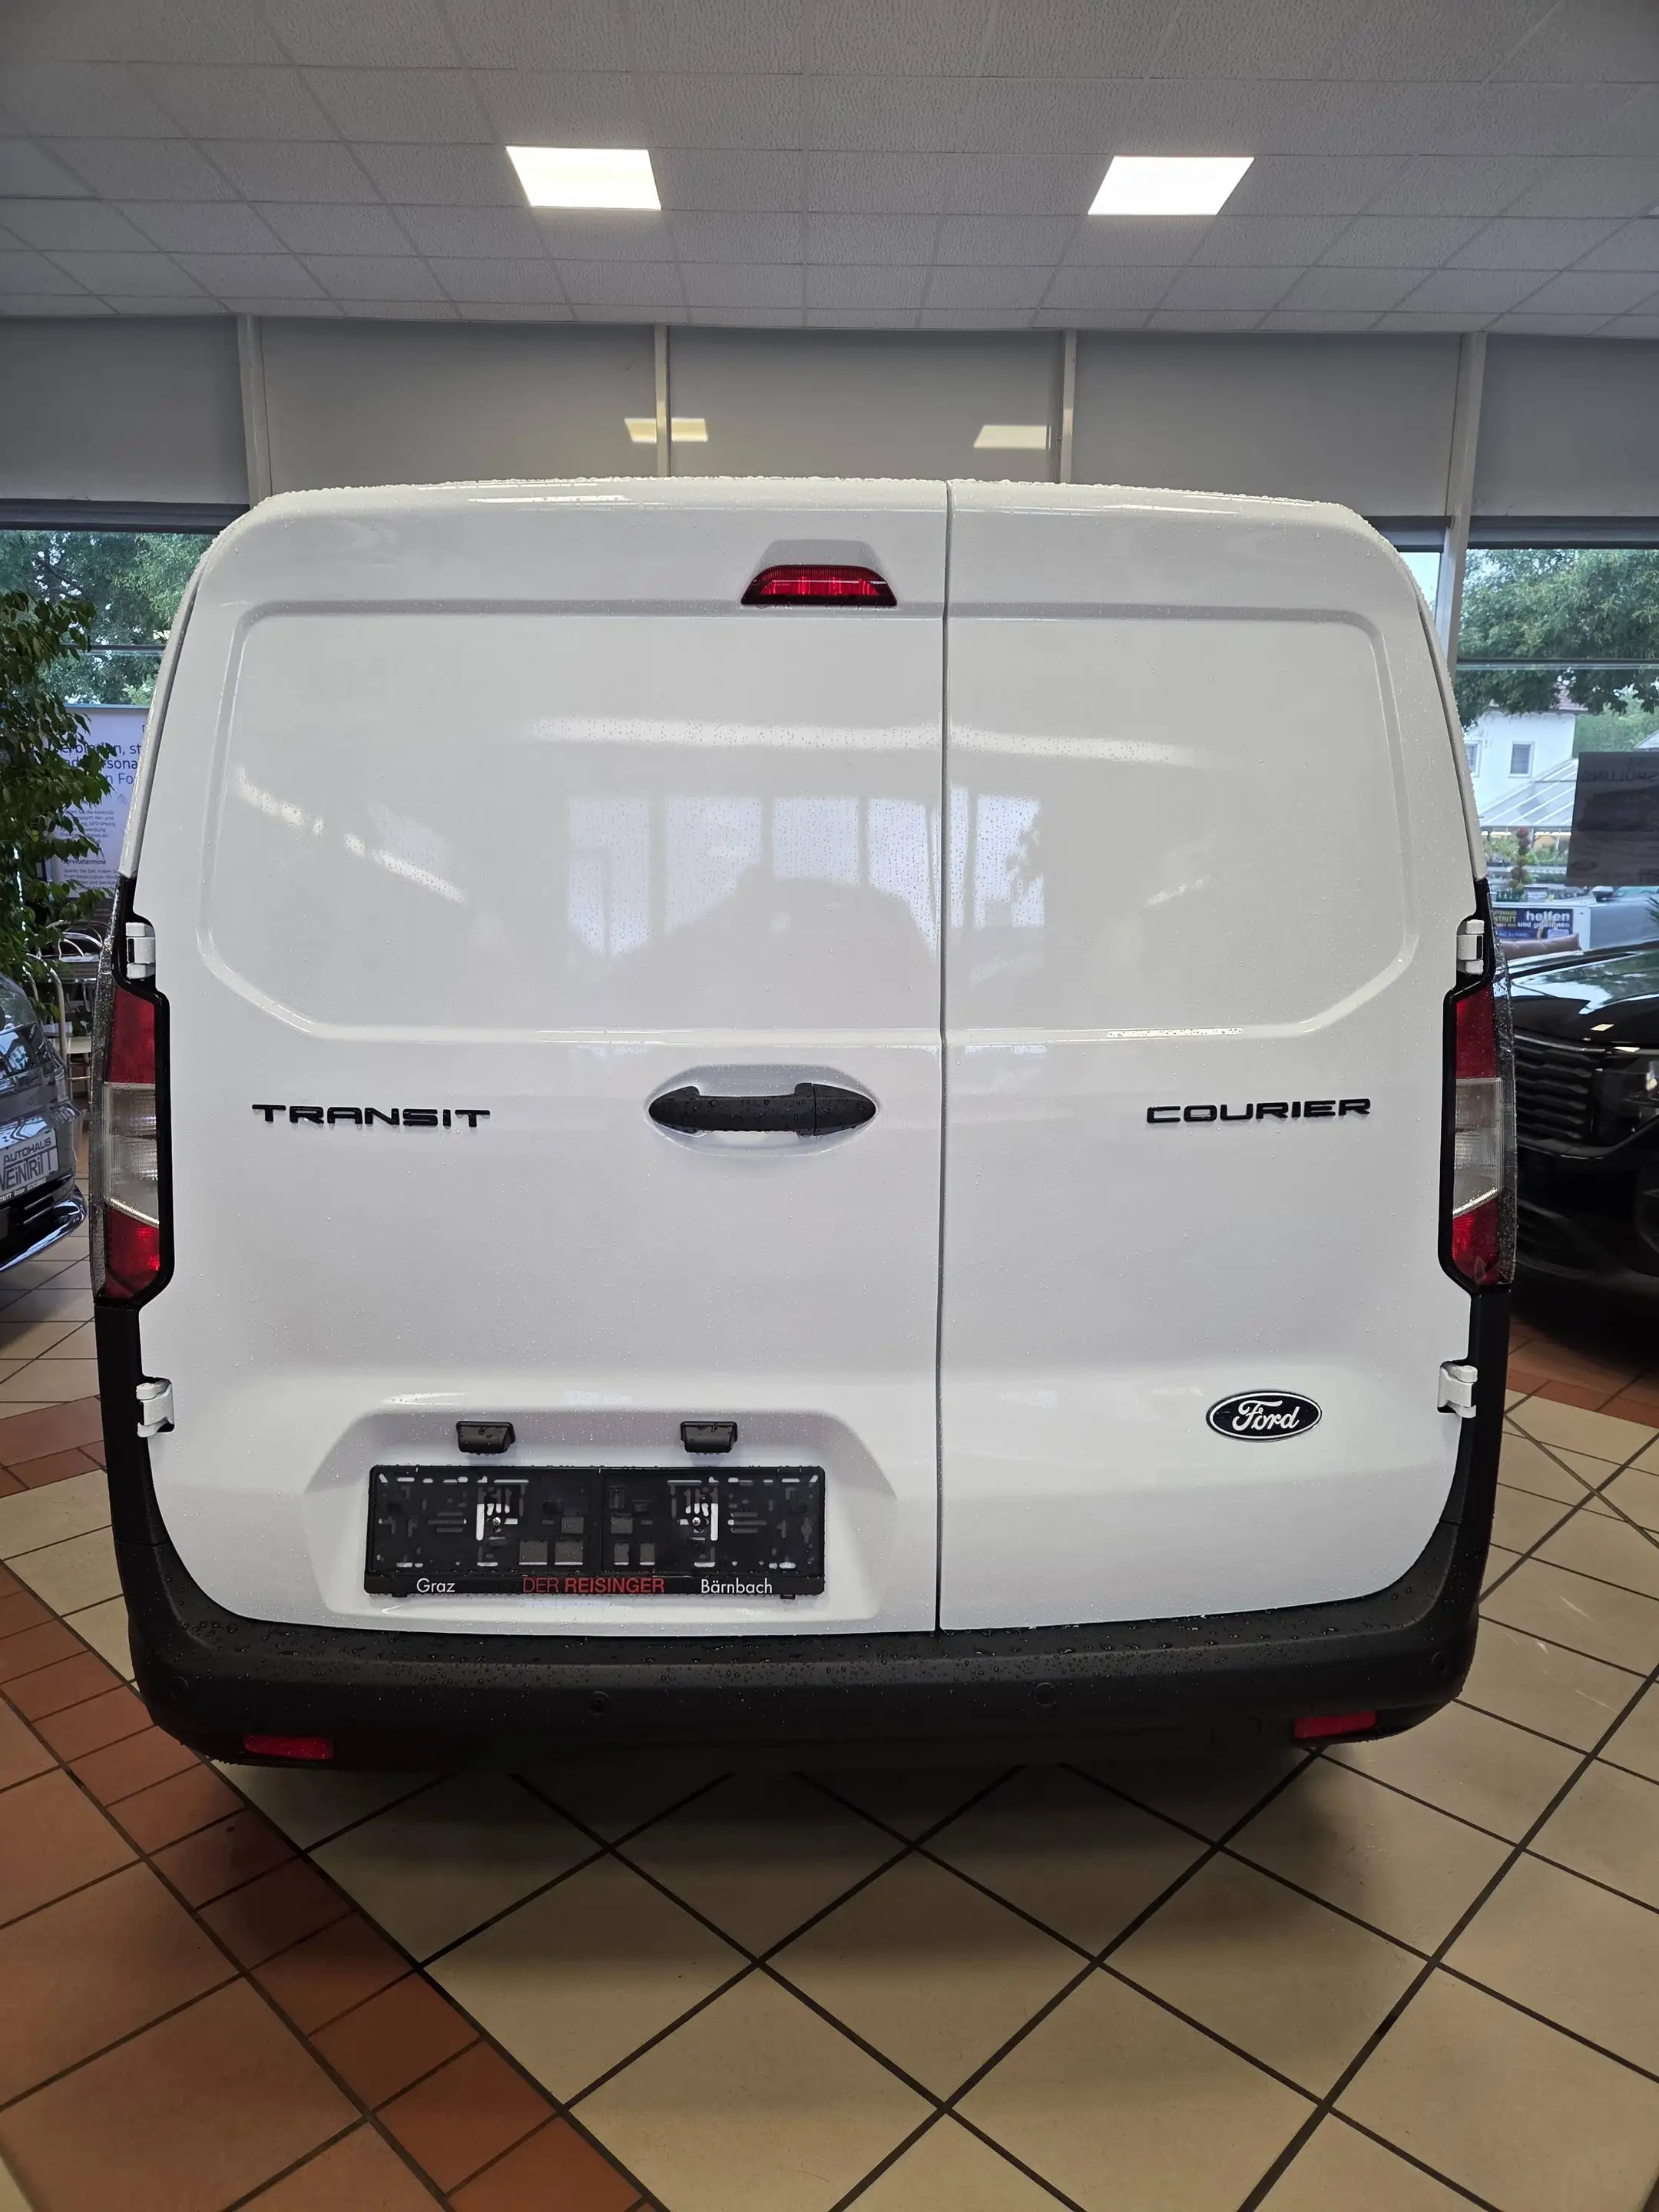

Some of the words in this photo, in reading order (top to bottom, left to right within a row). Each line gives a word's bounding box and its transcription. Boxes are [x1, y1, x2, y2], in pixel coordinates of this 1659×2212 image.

[1526, 910, 1570, 921] helfen
[252, 1104, 490, 1128] TRANSIT
[1147, 1098, 1370, 1124] COURIER
[3, 1137, 51, 1167] AUTOHAUS
[1232, 1399, 1300, 1431] Ford
[416, 1578, 455, 1594] Graz
[522, 1577, 558, 1594] DER
[565, 1577, 664, 1594] REISINGER
[701, 1578, 773, 1594] Bärnbach
